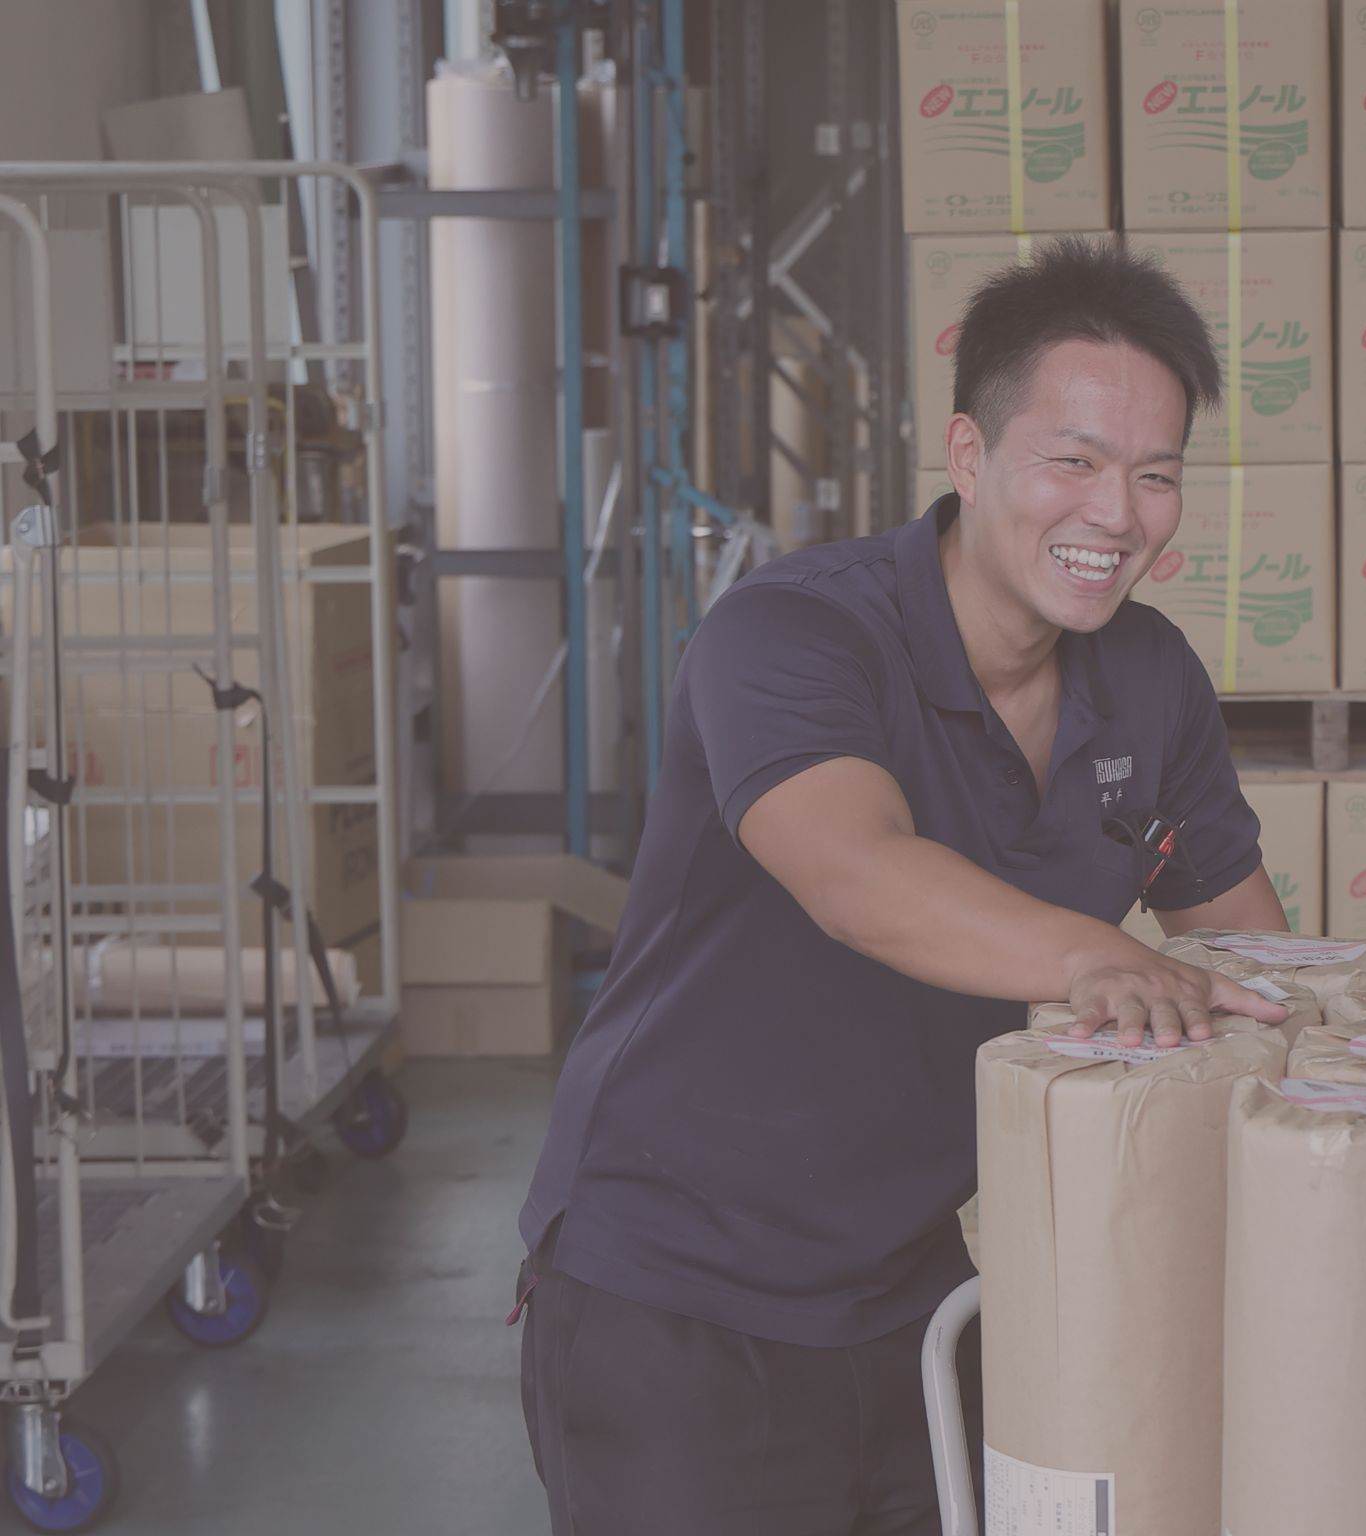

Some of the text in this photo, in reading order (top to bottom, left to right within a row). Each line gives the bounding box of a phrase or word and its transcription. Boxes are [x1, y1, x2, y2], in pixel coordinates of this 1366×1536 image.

[953, 87, 1083, 117] エコノール
[1093, 756, 1133, 784] TSUKASA
